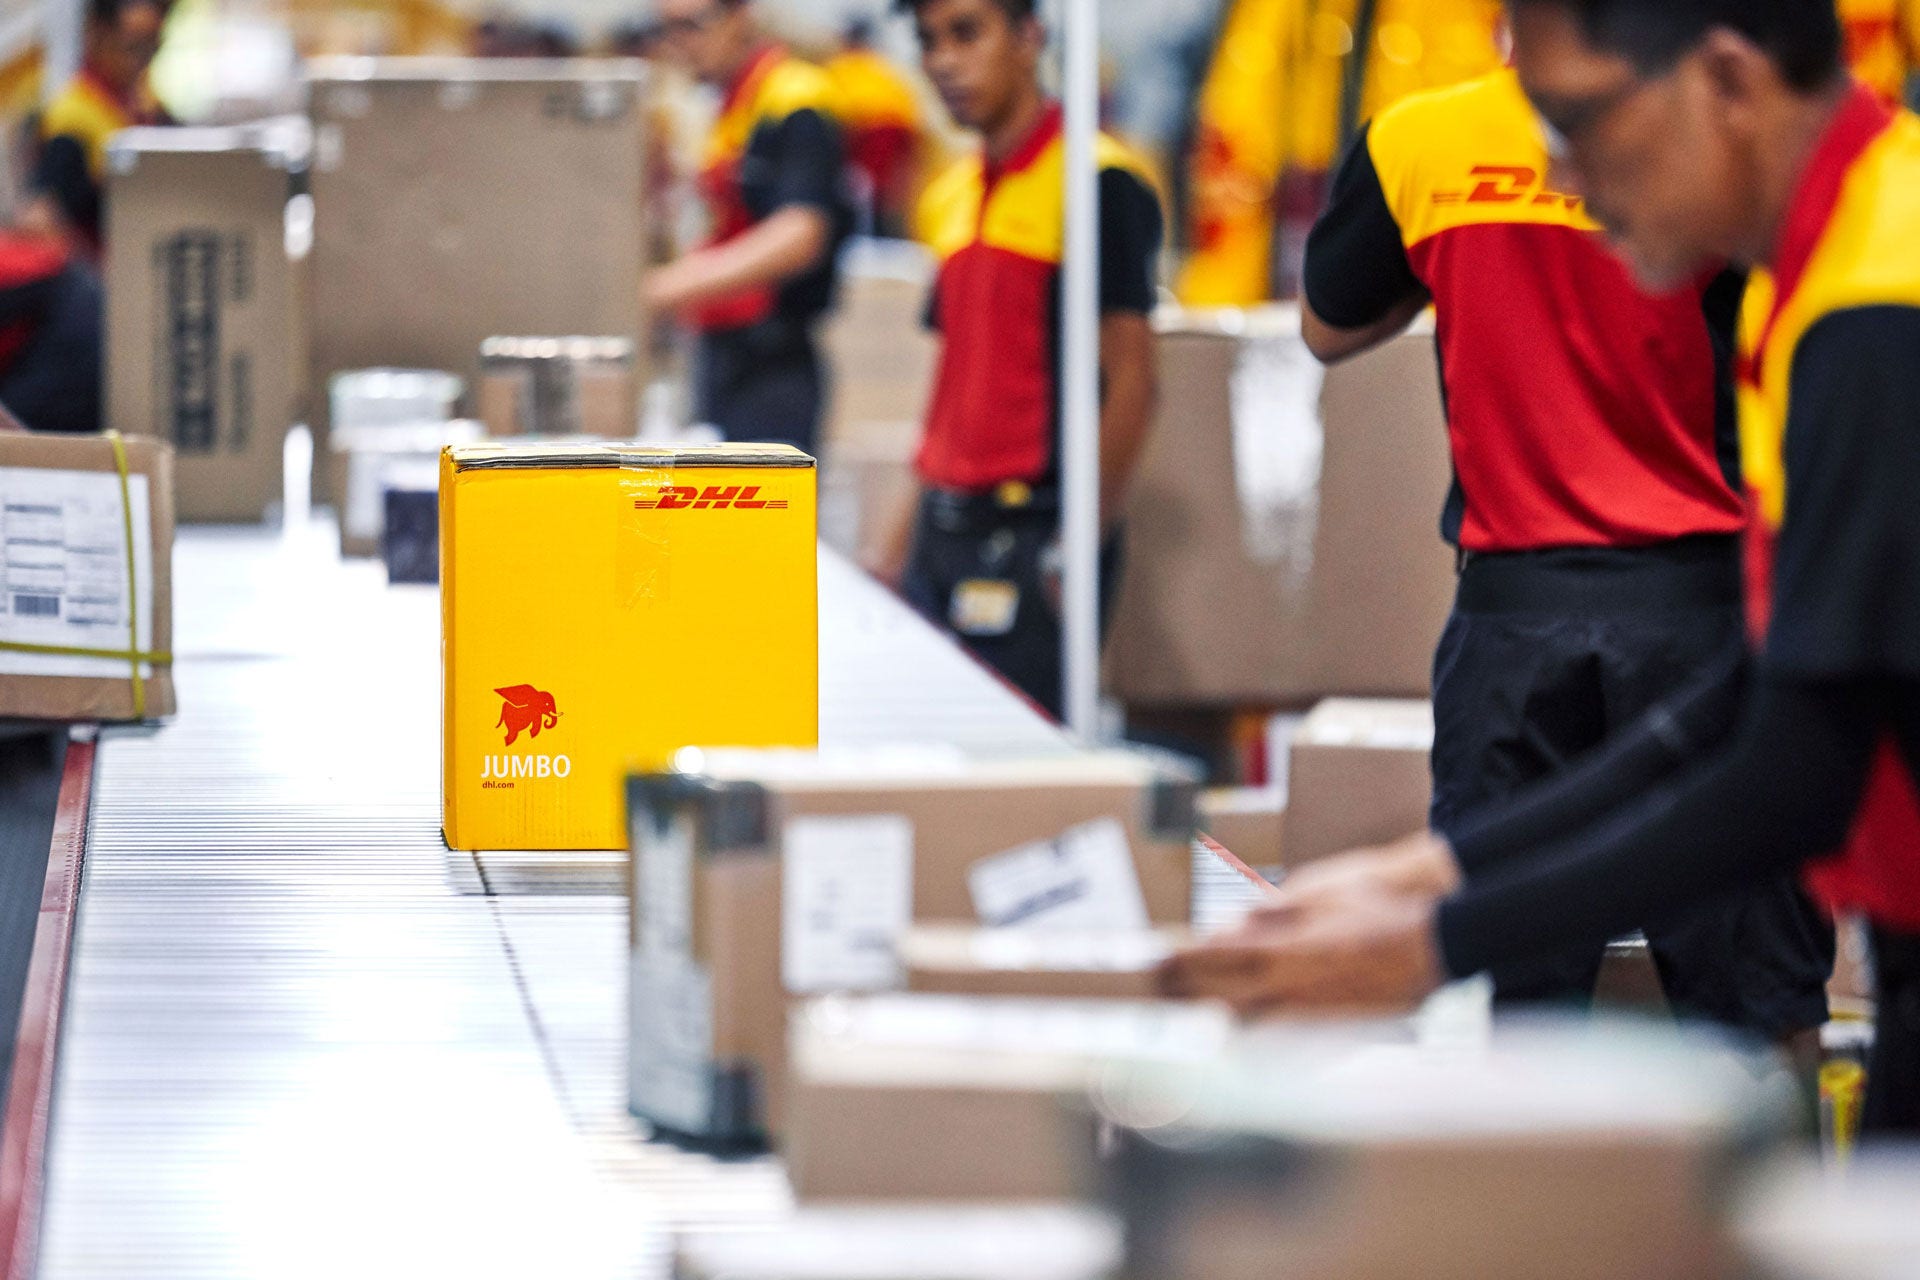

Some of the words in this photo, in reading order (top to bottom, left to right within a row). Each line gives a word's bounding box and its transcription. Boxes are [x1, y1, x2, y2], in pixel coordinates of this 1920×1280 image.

[652, 486, 770, 509] DHL
[480, 754, 571, 778] JUMBO
[481, 780, 516, 789] dhl.com
